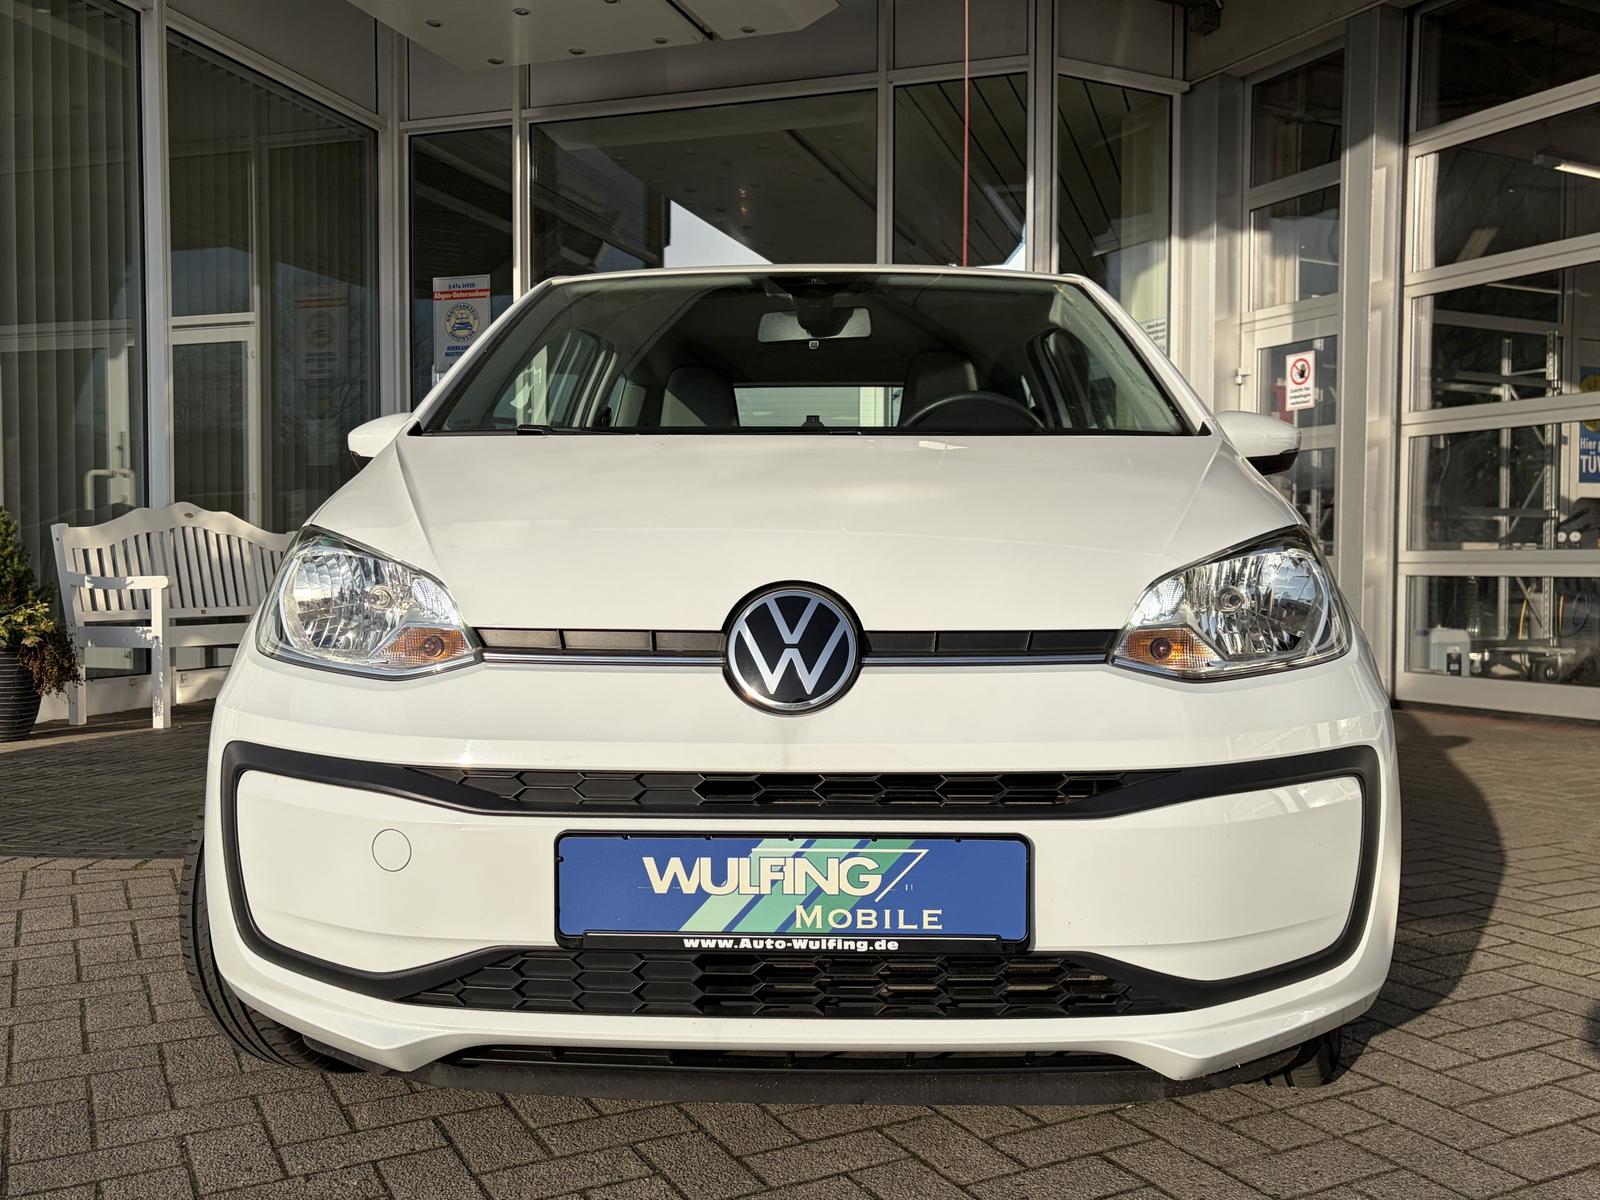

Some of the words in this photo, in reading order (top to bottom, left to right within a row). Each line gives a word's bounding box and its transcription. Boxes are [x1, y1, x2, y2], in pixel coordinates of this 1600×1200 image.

[1580, 437, 1596, 449] Hier
[642, 856, 882, 897] WULFING
[683, 937, 899, 952] www.Auto-Wulfing.de
